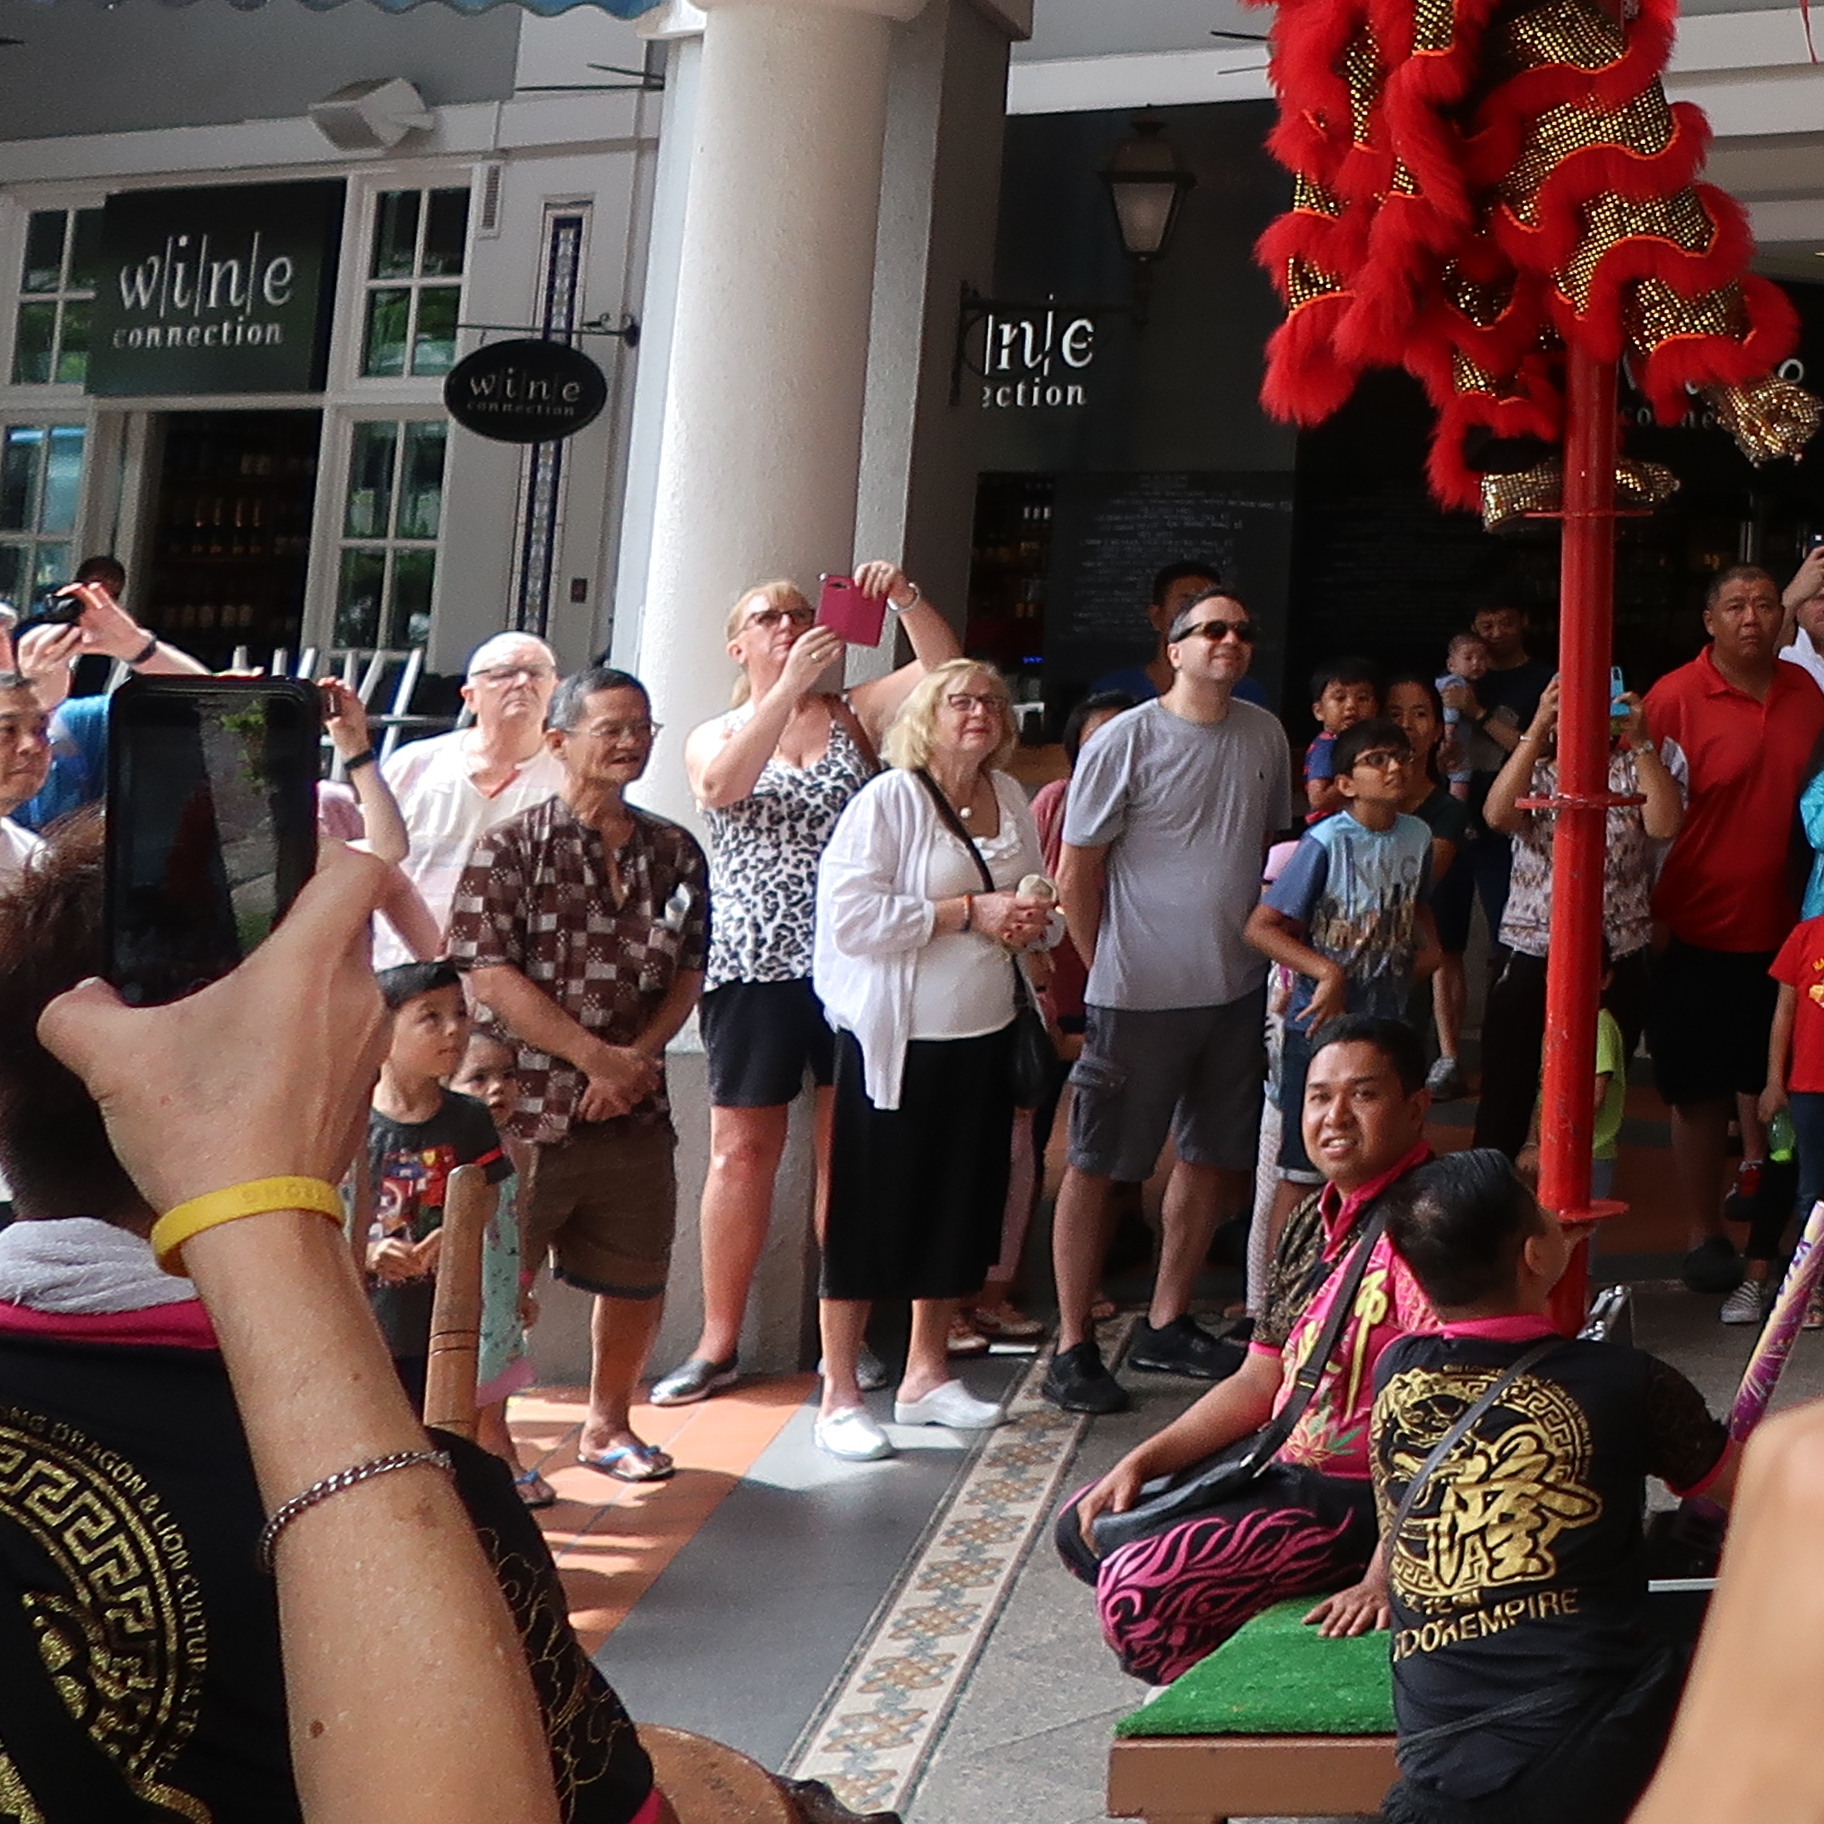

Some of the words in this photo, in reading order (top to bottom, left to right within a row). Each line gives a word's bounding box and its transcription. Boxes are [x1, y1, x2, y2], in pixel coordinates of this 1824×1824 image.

[112, 314, 284, 350] connection
[466, 398, 576, 417] connection
[49, 1421, 148, 1495] DRAGON
[151, 1510, 190, 1571] LION
